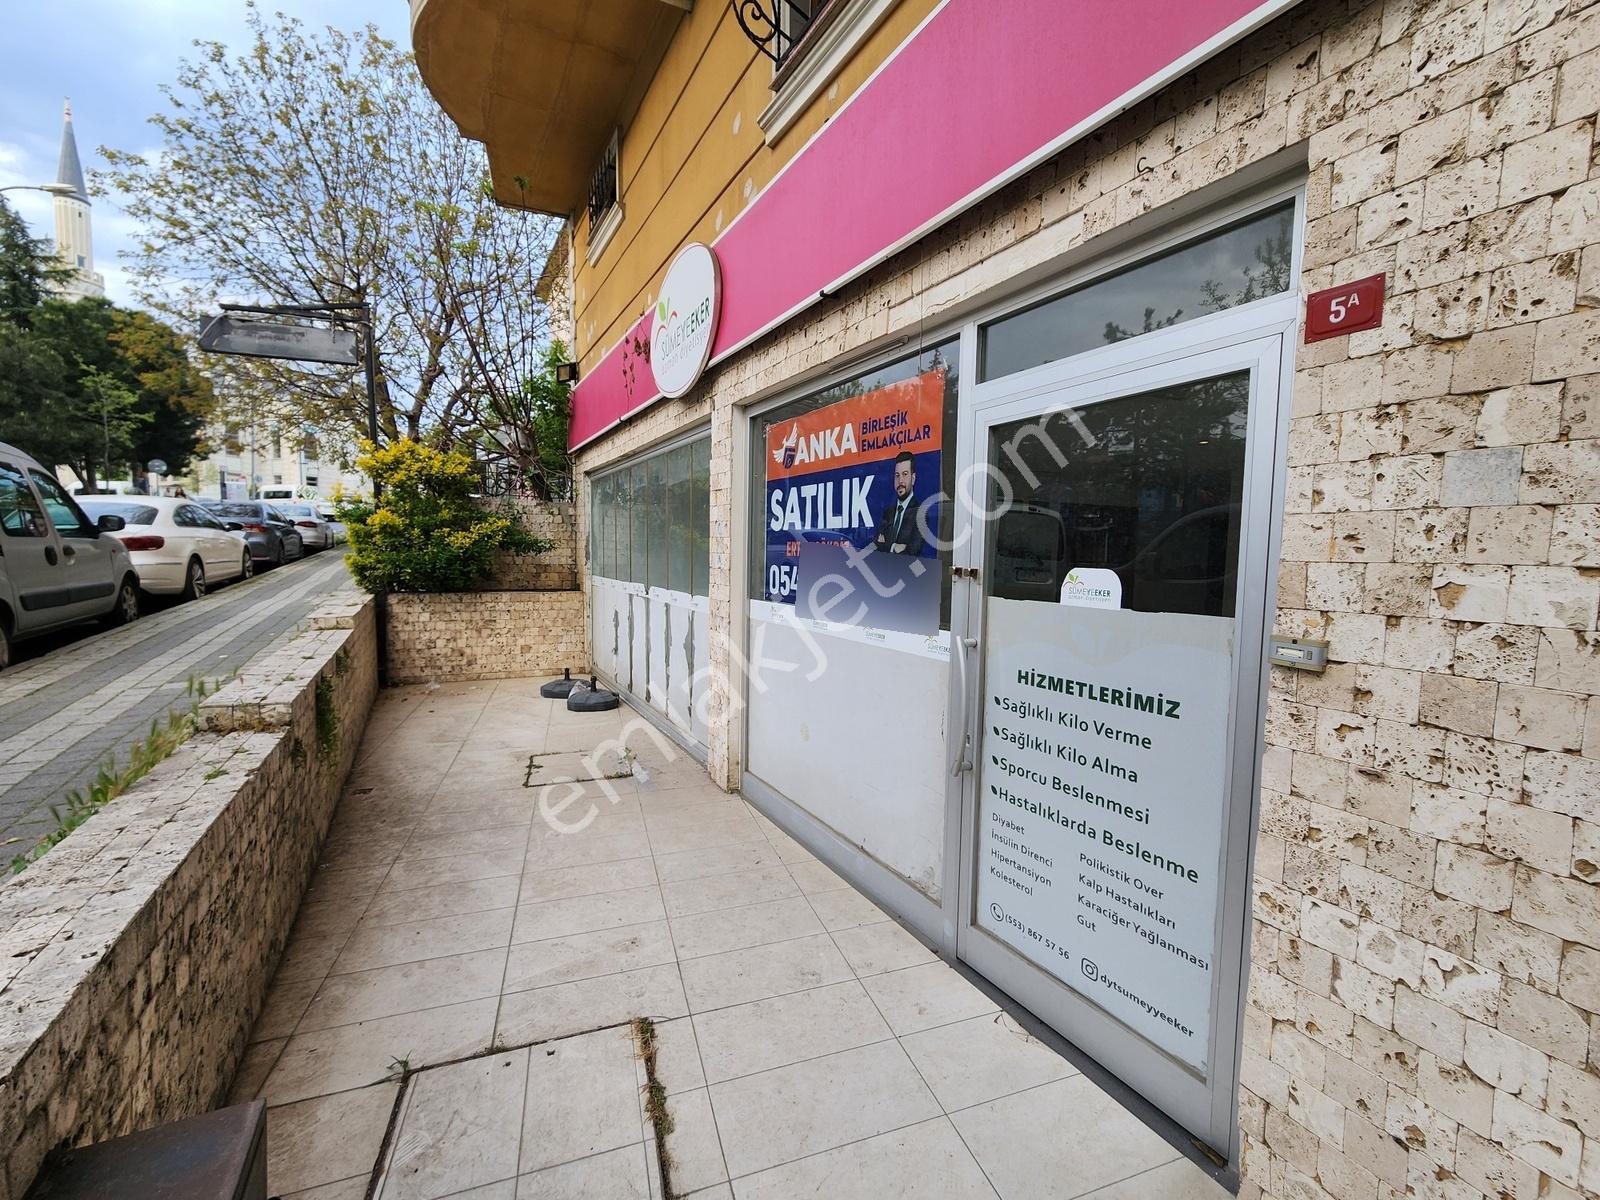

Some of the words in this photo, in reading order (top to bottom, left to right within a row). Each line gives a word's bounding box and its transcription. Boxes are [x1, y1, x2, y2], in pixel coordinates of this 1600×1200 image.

[794, 422, 857, 465] ANKA
[861, 409, 908, 435] BİRLEŞİK
[861, 424, 931, 453] EMLAKÇILAR
[770, 474, 875, 532] SATILIK
[1017, 668, 1181, 719] HİZMETLERİMİZ
[1002, 697, 1053, 722] Sağlıklı
[1058, 711, 1089, 732] Kilo
[1093, 720, 1152, 749] Verme
[1001, 727, 1051, 755] Sağlıklı
[1057, 744, 1087, 766] Kilo
[1092, 756, 1138, 783] Alma
[1000, 758, 1047, 786] Sporcu
[1052, 776, 1150, 825] Beslenmesi
[992, 812, 1025, 835] Diyabet
[999, 787, 1097, 839] Hastalıklarda
[1102, 829, 1199, 884] Beslenme
[990, 848, 1052, 887] Hipertansiyon
[991, 828, 1019, 852] İnsülin
[1021, 844, 1053, 868] Direnci
[990, 866, 1033, 896] Kolesterol
[1079, 853, 1131, 885] Polikistik
[1133, 878, 1164, 900] Over
[1076, 914, 1097, 932] Gut
[1078, 873, 1103, 894] Kalp
[1105, 886, 1176, 930] Hastalıkları
[1005, 913, 1026, 935] (553)
[1027, 927, 1043, 943] 867
[1045, 938, 1056, 951] 57
[1058, 947, 1070, 960] 56
[1077, 894, 1132, 928] Karaciğer
[1132, 920, 1209, 971] Yağlanması
[1100, 973, 1194, 1038] dytsumeyyeeker
